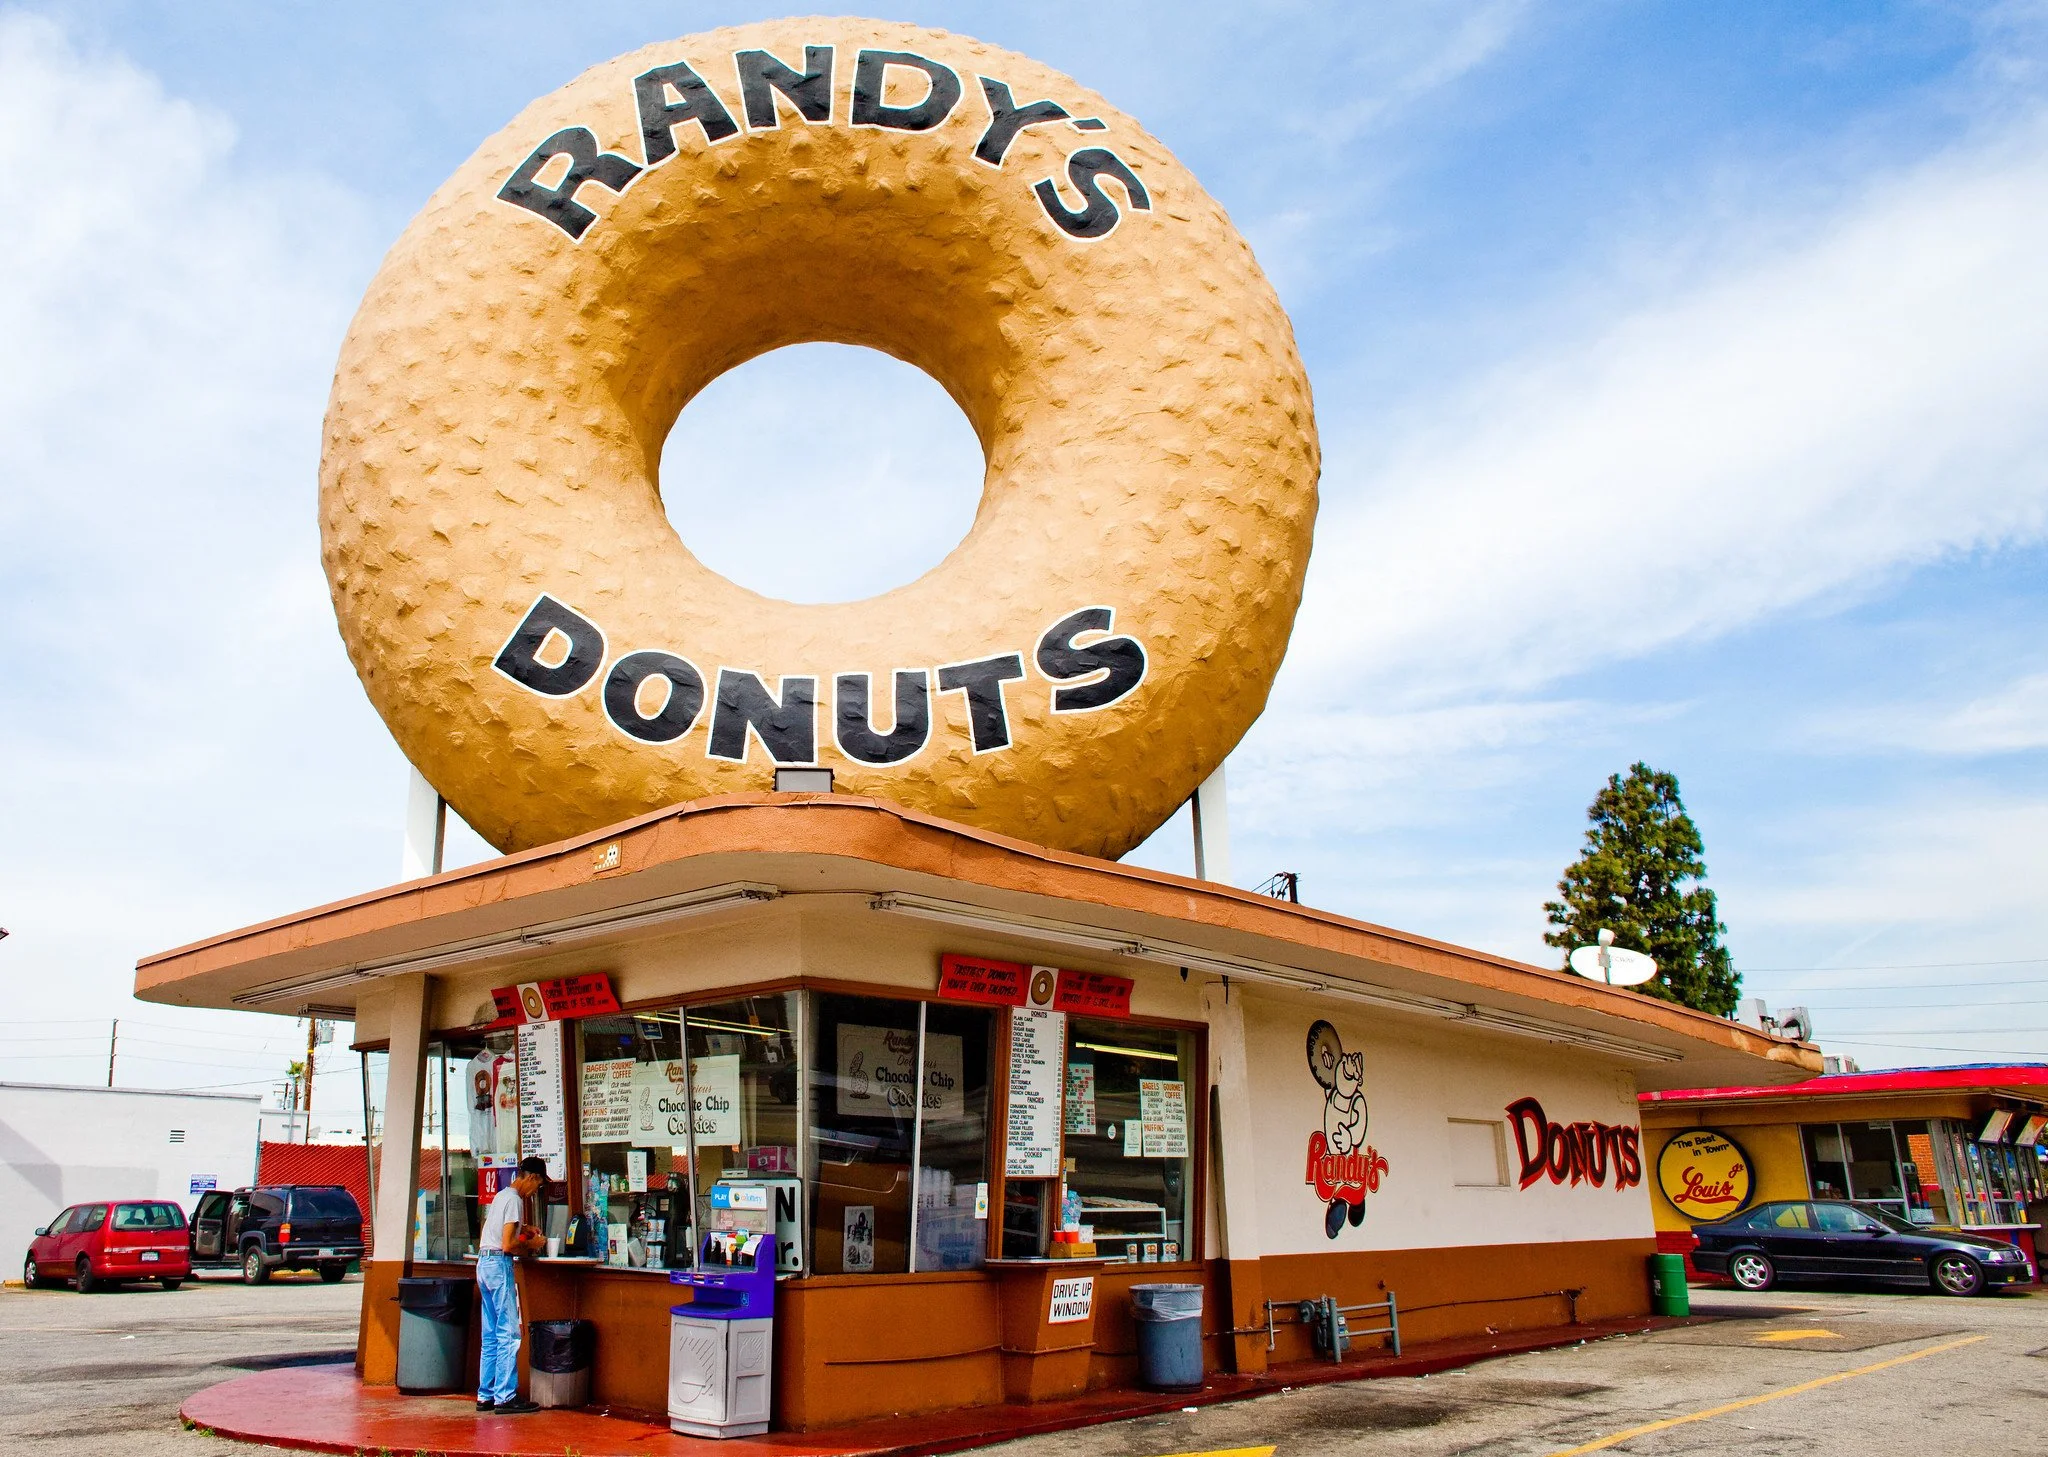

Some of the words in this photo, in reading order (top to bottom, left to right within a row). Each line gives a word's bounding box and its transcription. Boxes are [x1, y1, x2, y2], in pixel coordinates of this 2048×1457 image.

[495, 43, 1153, 244] RANDY'S
[490, 590, 1149, 768] DONUTS
[586, 1064, 608, 1073] BAGELS
[613, 1070, 632, 1079] COFFEE
[930, 1072, 955, 1090] Chip
[1142, 1082, 1160, 1090] BAGELS
[1163, 1083, 1183, 1092] GOURMET
[658, 1098, 702, 1113] Chocote
[705, 1095, 730, 1113] Chip
[887, 1085, 942, 1109] Cooies
[583, 1108, 608, 1116] MUFFINS
[1144, 1124, 1164, 1132] MUFFINS
[1504, 1096, 1641, 1192] DONUTS
[1694, 1134, 1716, 1145] Best
[1692, 1148, 1701, 1156] in
[1305, 1131, 1389, 1205] Randy's
[485, 1171, 496, 1193] 92
[1673, 1166, 1740, 1204] Louis
[776, 1241, 799, 1267] r.
[1053, 1283, 1079, 1298] DRIVE
[1082, 1282, 1092, 1296] UP
[1054, 1301, 1090, 1317] WINDOW
